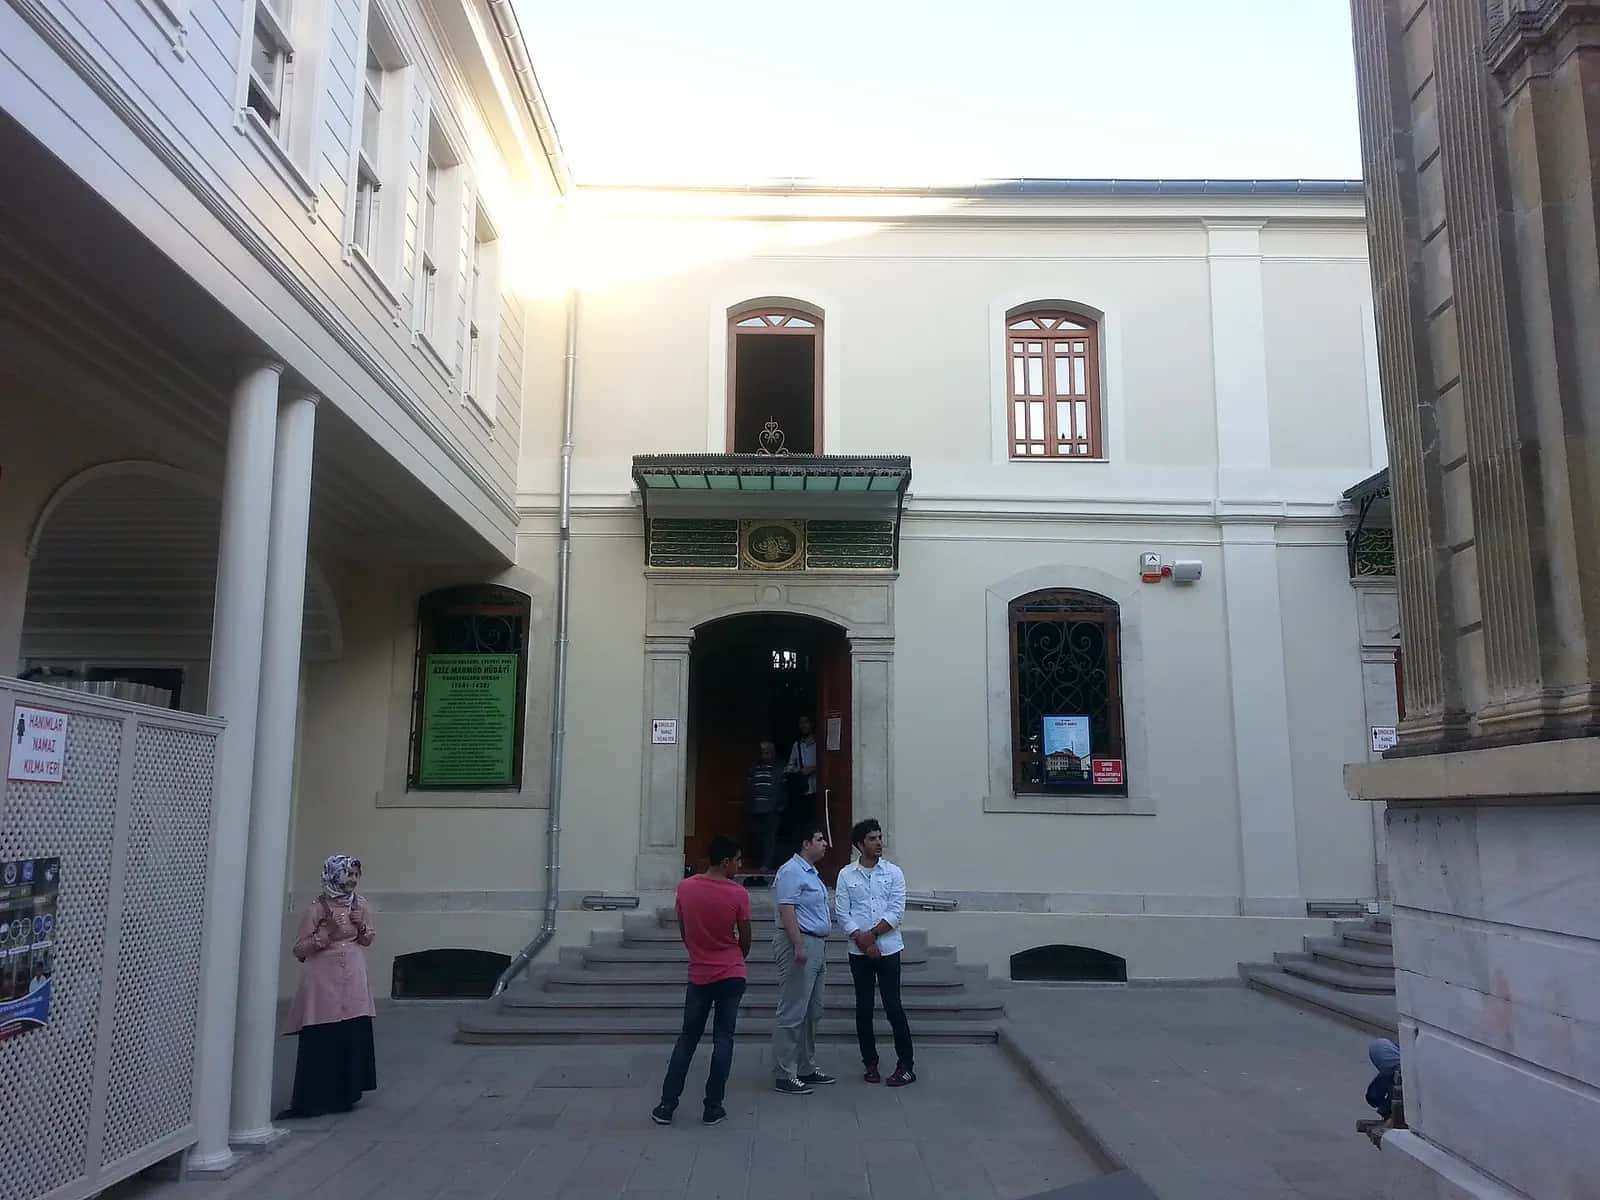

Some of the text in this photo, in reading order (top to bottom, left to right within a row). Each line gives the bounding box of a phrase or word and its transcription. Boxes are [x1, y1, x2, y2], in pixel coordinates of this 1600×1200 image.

[29, 714, 63, 731] HANIMLAR
[32, 737, 56, 752] NAMAZ
[24, 759, 45, 774] KILMA
